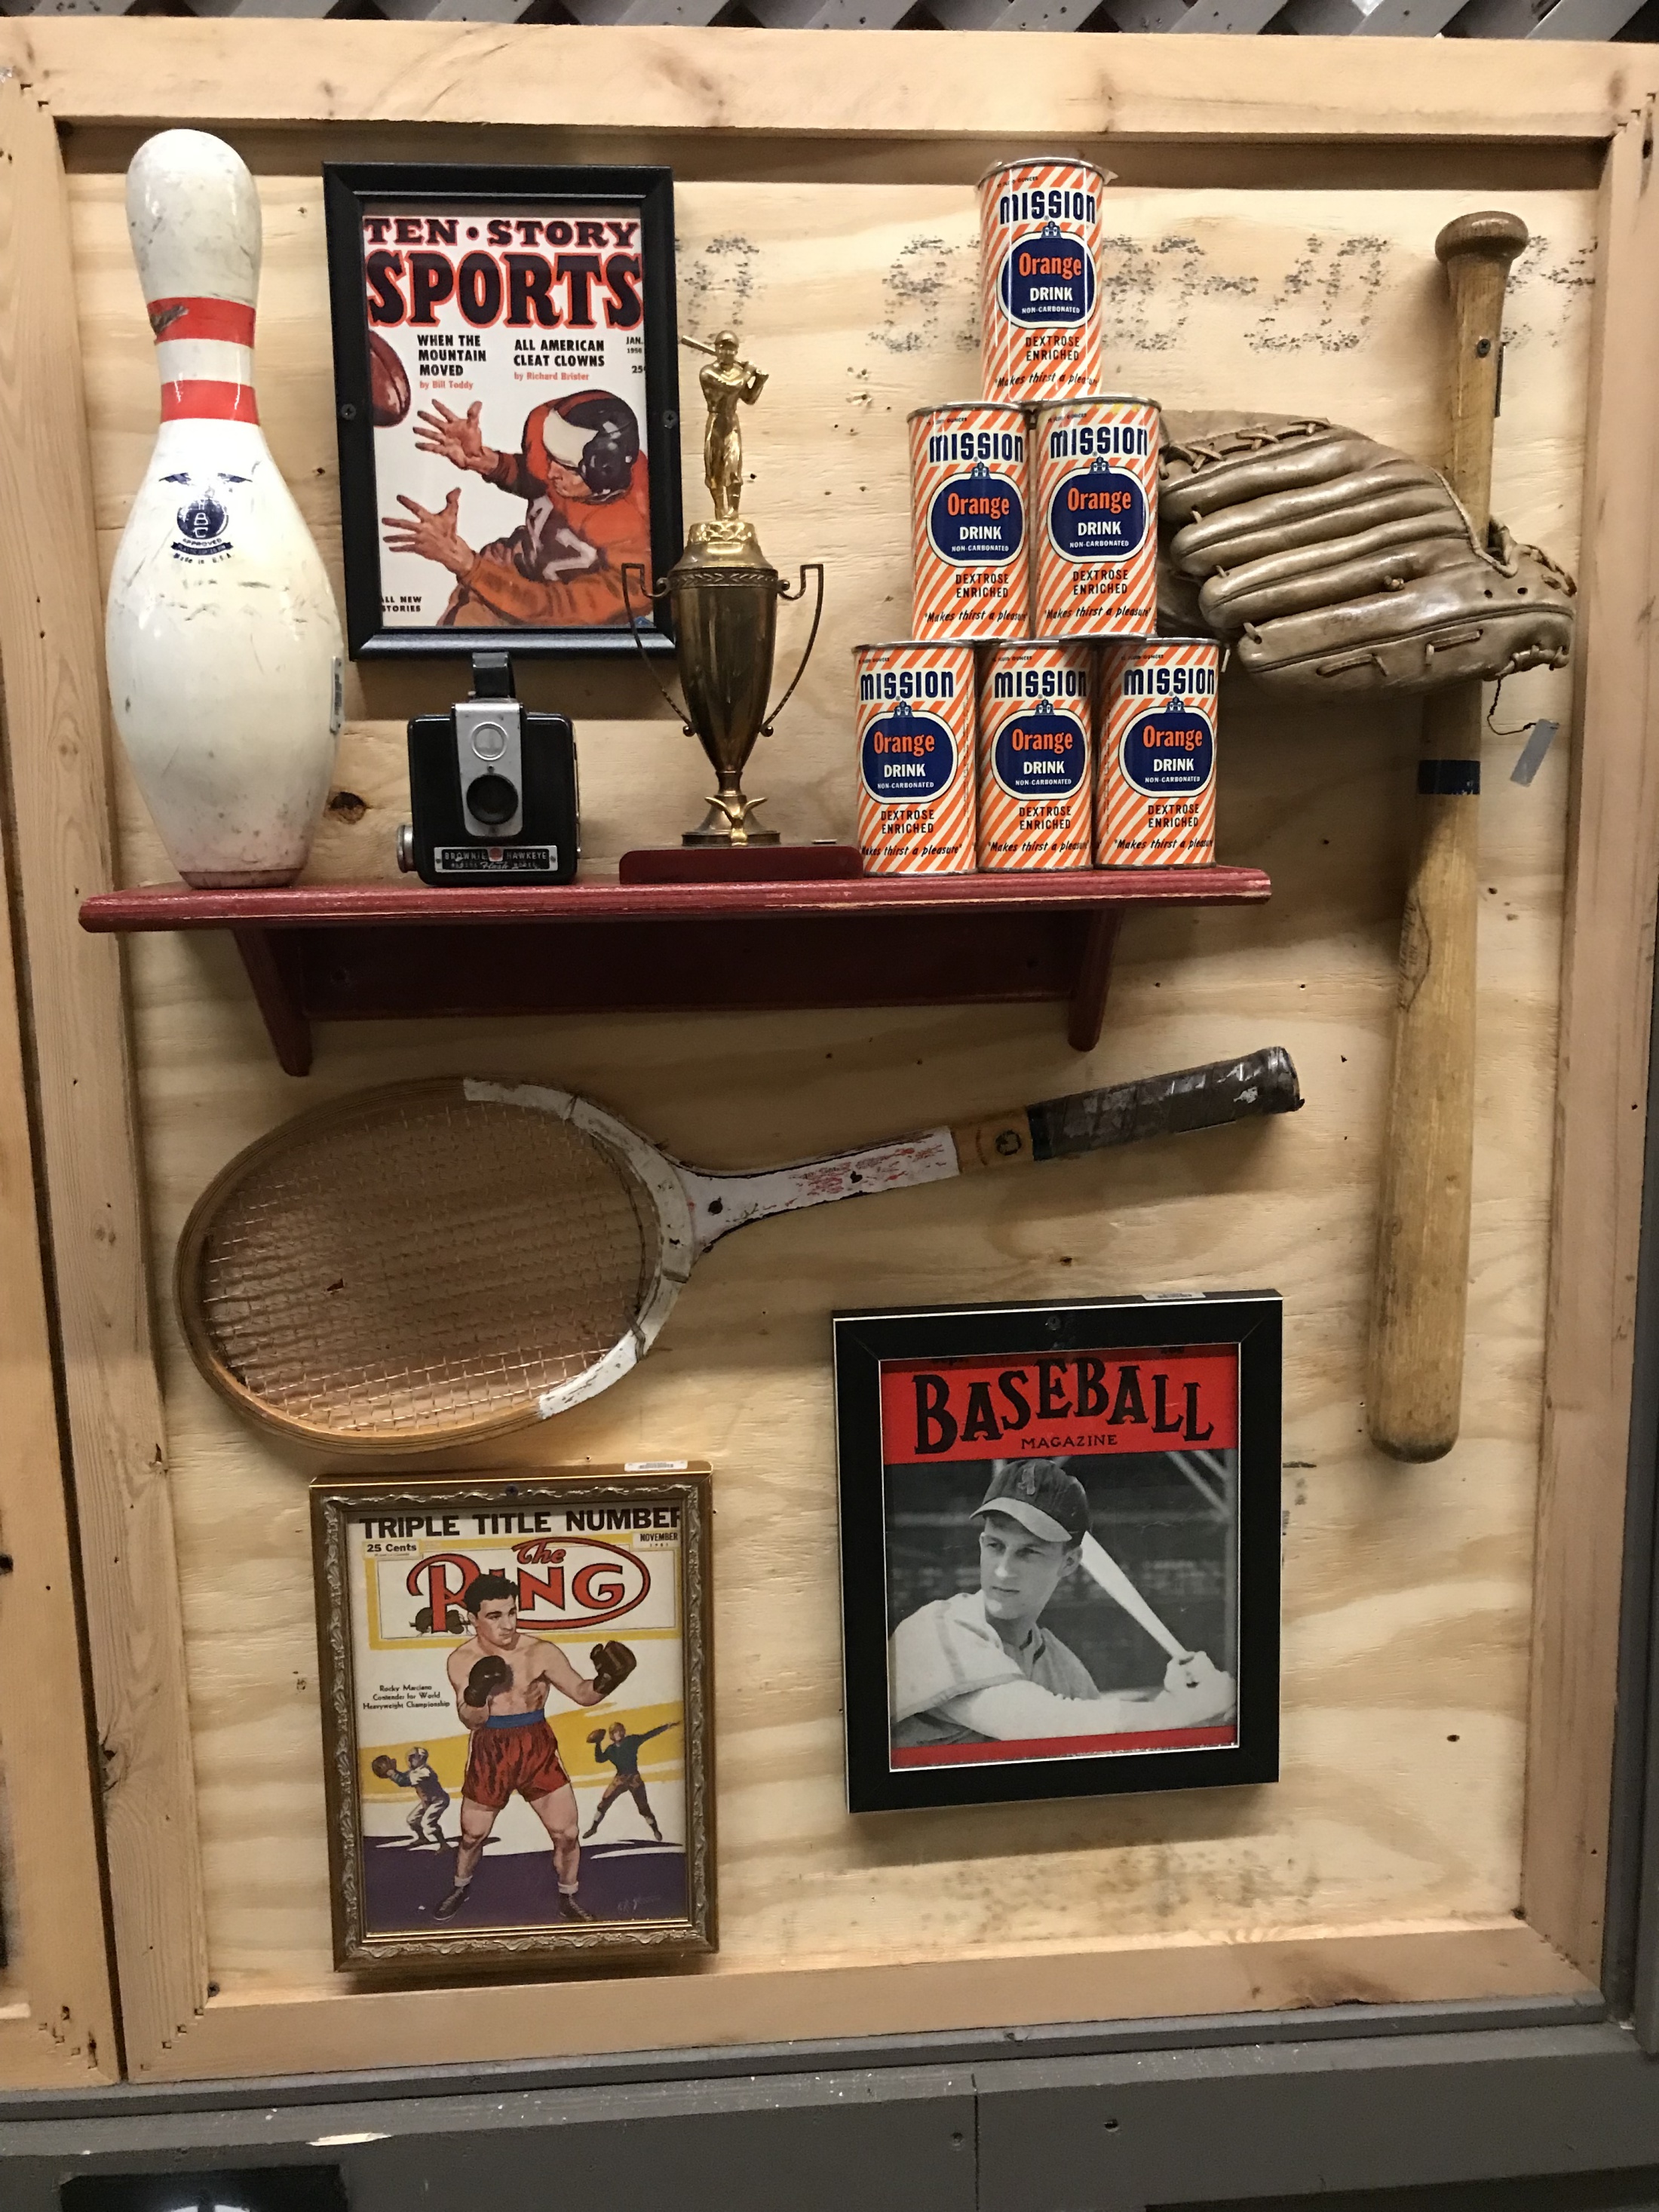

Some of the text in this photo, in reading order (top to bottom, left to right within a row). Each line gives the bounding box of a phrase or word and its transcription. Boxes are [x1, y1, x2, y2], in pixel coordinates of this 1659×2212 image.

[364, 218, 639, 248] TEN STORY
[1019, 252, 1082, 280] Orange
[366, 249, 642, 330] SPORTS
[1029, 287, 1073, 302] DRINK
[417, 334, 480, 347] WHEN THE
[514, 339, 604, 351] ALL AMERICAN
[1026, 336, 1079, 348] DEXTROSE
[419, 349, 486, 361] MOUNTAIN
[514, 354, 605, 367] CLEAT CLOWNS
[1026, 350, 1079, 361] ENRICHED
[419, 364, 463, 376] MOVED
[514, 372, 523, 381] by
[526, 372, 557, 380] Richard
[1029, 372, 1056, 383] thirst
[1059, 373, 1066, 382] a
[419, 381, 429, 390] by
[947, 492, 1009, 520] Orange
[1067, 487, 1131, 514] Orange
[959, 526, 1001, 540] DRINK
[1078, 521, 1121, 536] DRINK
[955, 573, 1008, 584] DEXTROSE
[1073, 569, 1129, 581] DEXTROSE
[956, 587, 1008, 598] ENRICHED
[1073, 584, 1128, 595] ENRICHED
[958, 609, 986, 621] thirst
[1075, 606, 1103, 617] thirst
[874, 731, 935, 757] Orange
[1012, 729, 1073, 754] Orange
[1143, 725, 1203, 751] Orange
[884, 763, 925, 778] DRINK
[1023, 761, 1065, 775] DRINK
[1153, 758, 1194, 772] DRINK
[881, 809, 934, 821] DEXTROSE
[1020, 805, 1072, 817] DEXTROSE
[1148, 804, 1199, 815] DEXTROSE
[882, 823, 934, 834] ENRICHED
[1020, 819, 1071, 830] ENRICHED
[1148, 817, 1198, 828] ENRICHED
[1022, 841, 1048, 851] thirst
[1150, 839, 1177, 848] thirst
[444, 851, 547, 860] BROWNIE HAWKEYE
[884, 845, 909, 855] thirst
[912, 847, 918, 855] a
[911, 1357, 1214, 1456] BASEBALL
[1020, 1434, 1118, 1450] MAGAZINE
[358, 1515, 460, 1539] TRIPLE
[473, 1511, 552, 1535] TITLE
[639, 1532, 678, 1542] NOVEMBER
[366, 1544, 382, 1552] 25
[385, 1543, 417, 1552] Cents
[511, 1540, 567, 1565] The
[406, 1552, 625, 1634] RNG
[363, 1700, 450, 1710] Heavyweight Championship
